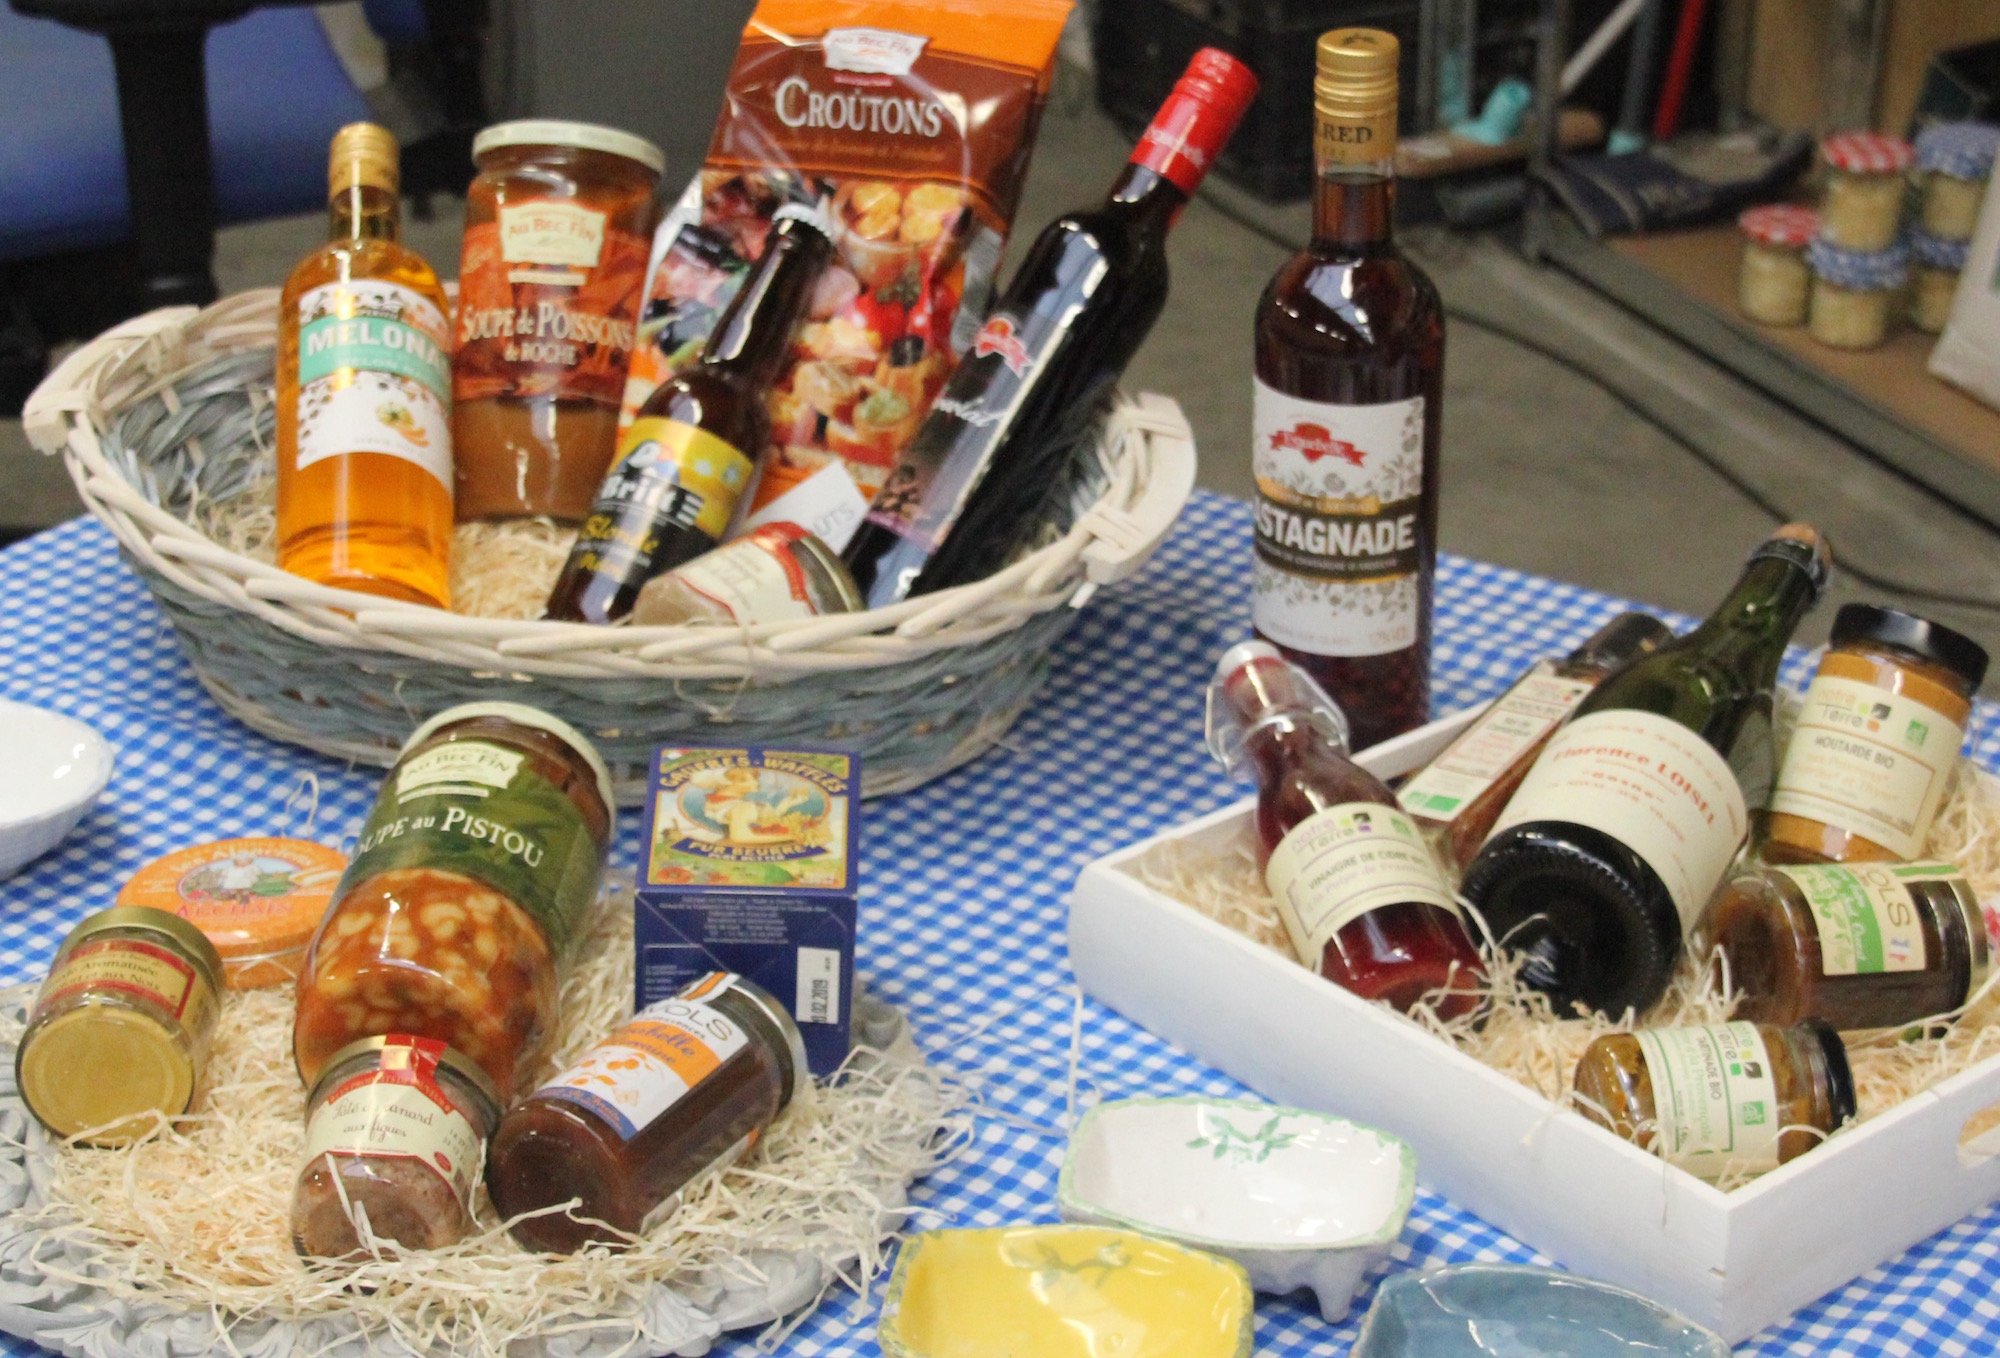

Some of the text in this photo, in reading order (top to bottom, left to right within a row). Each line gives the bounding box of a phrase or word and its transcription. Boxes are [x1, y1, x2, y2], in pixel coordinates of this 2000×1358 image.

[411, 815, 435, 830] au
[440, 806, 544, 868] PISTOU
[385, 1103, 434, 1126] anard
